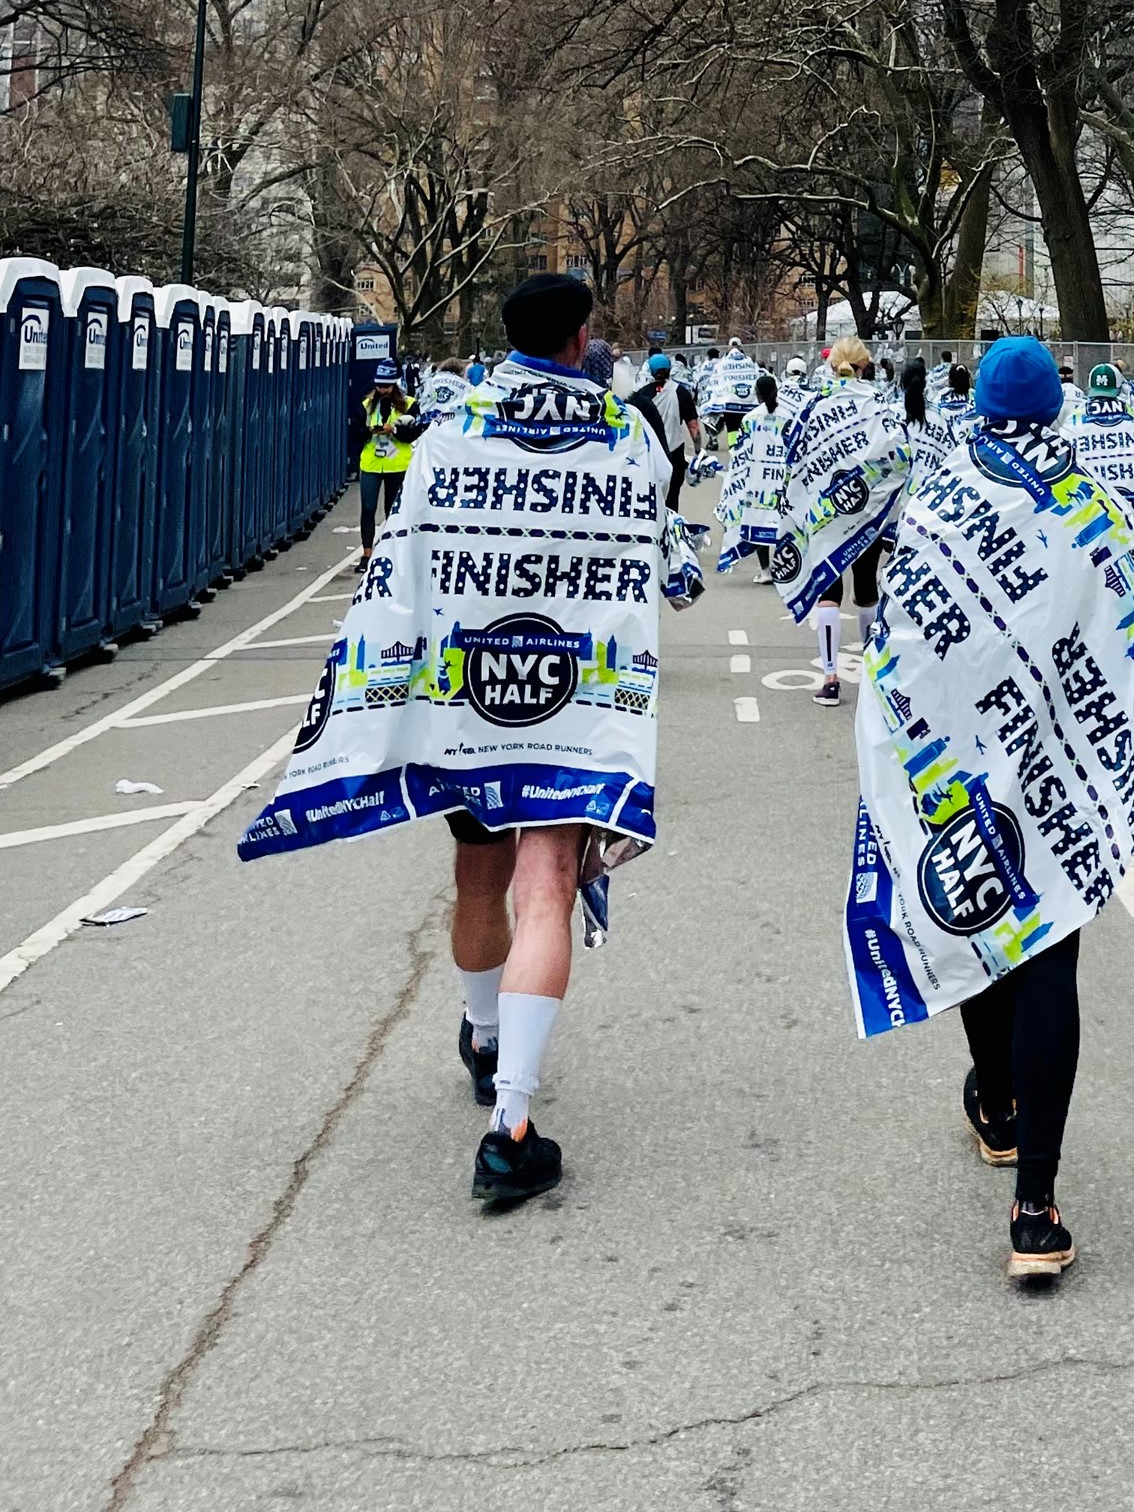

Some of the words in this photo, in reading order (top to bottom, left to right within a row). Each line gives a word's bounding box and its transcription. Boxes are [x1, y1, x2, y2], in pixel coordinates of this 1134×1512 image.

[360, 342, 389, 350] United
[1096, 375, 1108, 386] M
[514, 387, 591, 421] NYC
[1090, 401, 1123, 414] NYC
[562, 426, 606, 436] UNITED
[991, 420, 1058, 473] NYC
[835, 479, 861, 504] NYC
[1011, 461, 1045, 496] UNITED
[428, 467, 657, 521] FINISHER
[775, 558, 797, 579] HALF
[464, 636, 509, 646] UNITED
[526, 637, 580, 648] AIRLINES
[481, 651, 560, 685] NYC
[484, 684, 553, 706] HALF
[478, 745, 498, 753] NEW
[501, 742, 525, 751] YORK
[528, 742, 553, 751] ROAD
[555, 745, 592, 755] RUNNERS
[974, 675, 1114, 918] FINISHER
[975, 792, 995, 835] UNITED
[997, 849, 1026, 900] AIRLINES
[950, 819, 1004, 912] NYC
[931, 848, 974, 919] HALF
